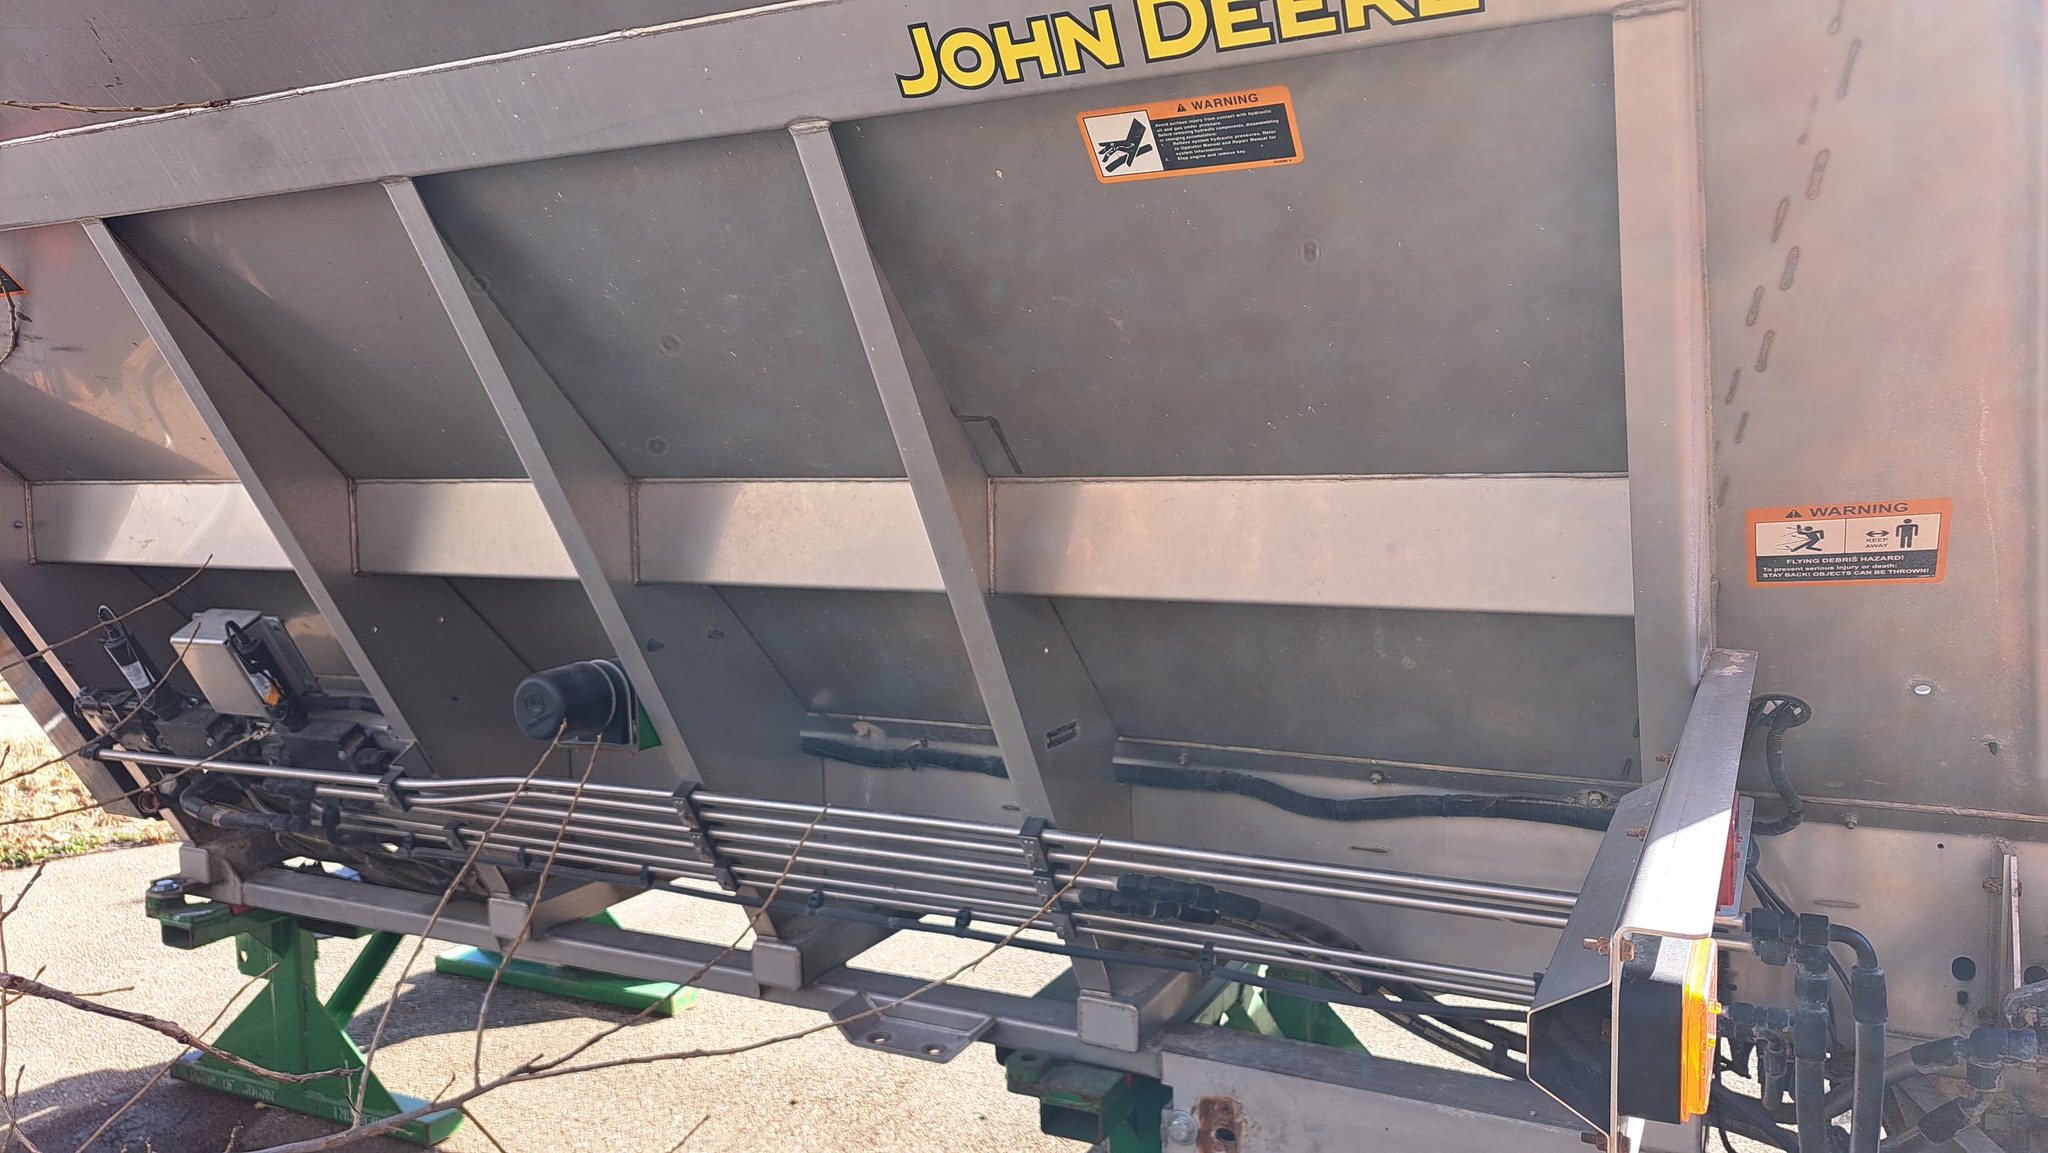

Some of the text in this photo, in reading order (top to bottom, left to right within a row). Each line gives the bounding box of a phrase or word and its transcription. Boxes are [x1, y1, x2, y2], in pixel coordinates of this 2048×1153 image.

[896, 0, 1485, 98] JOHN DEE
[1191, 93, 1258, 110] WARNING
[1810, 502, 1908, 517] WARNING
